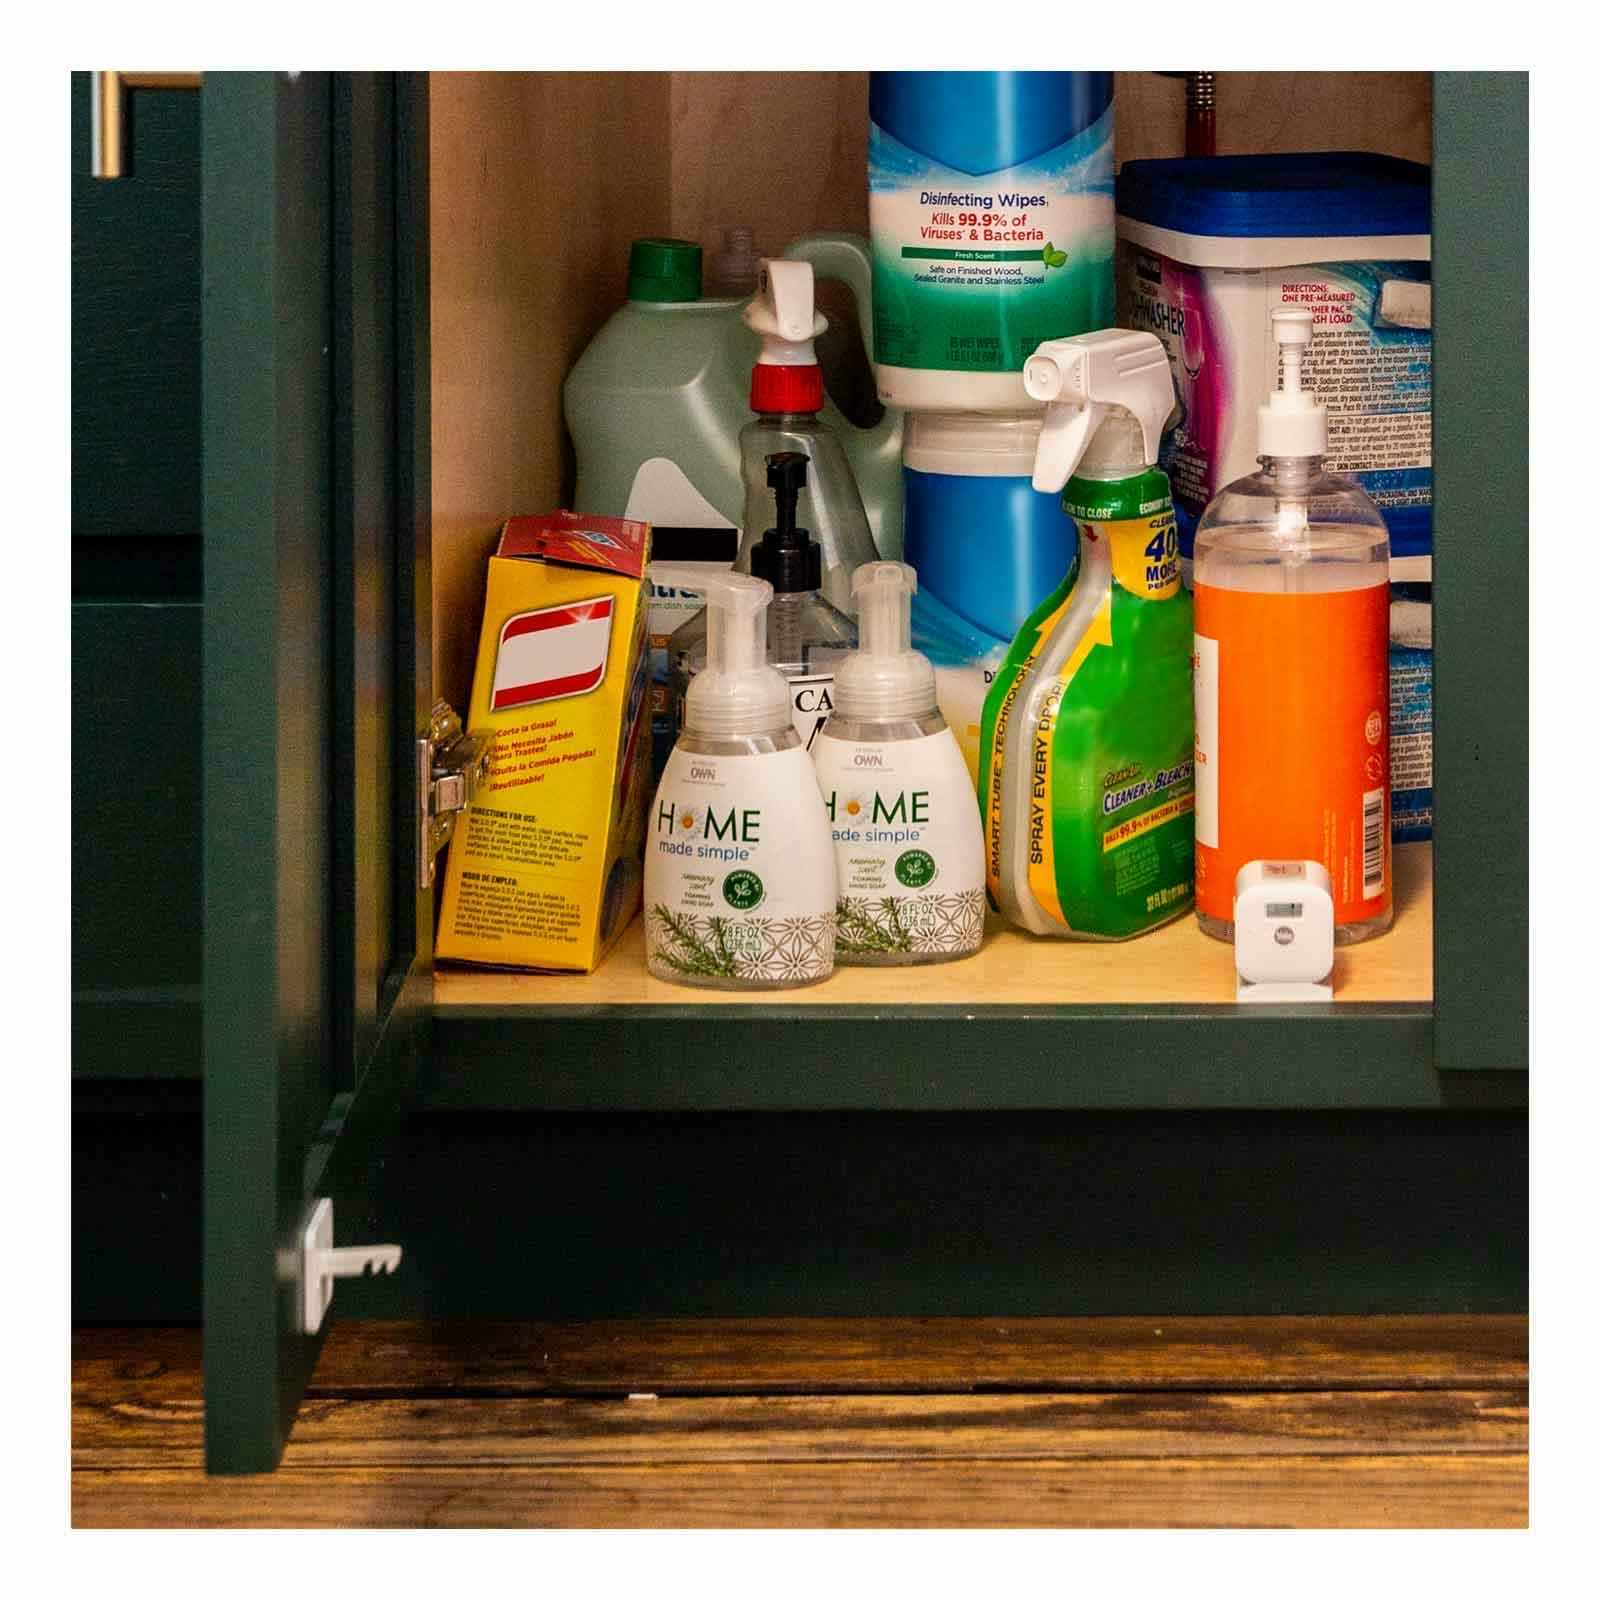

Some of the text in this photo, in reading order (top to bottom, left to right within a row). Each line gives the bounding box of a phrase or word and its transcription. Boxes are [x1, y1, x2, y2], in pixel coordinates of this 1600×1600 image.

[919, 192, 993, 209] Disinfecting
[931, 213, 1027, 227] Kills 99.9% of
[969, 229, 979, 240] &
[983, 228, 1044, 241] Bacteria
[955, 251, 995, 260] Fresh Scent
[929, 265, 945, 274] Safe
[958, 266, 992, 276] Finished
[993, 266, 1024, 277] Wood,
[914, 274, 1045, 285] Sealed Granite and Stainless Steel
[1282, 284, 1328, 293] DIRECTIONS:
[1282, 293, 1356, 302] ONE PRE-MEASURED
[1331, 305, 1344, 313] PAC
[1329, 313, 1353, 324] LOAD
[1087, 507, 1113, 520] CLOSE
[1144, 526, 1176, 563] 40
[995, 655, 1036, 755] TECHNOLOGY
[511, 736, 547, 749] Necesita
[528, 757, 561, 769] Comida
[853, 755, 883, 767] OWN
[690, 768, 716, 781] OWN
[1033, 738, 1048, 799] EVERY
[471, 806, 508, 819] DIRECTIONS
[509, 809, 522, 821] FOR
[832, 828, 920, 844] ade simple
[1030, 805, 1044, 865] SPRAY
[659, 840, 750, 862] made simple
[991, 820, 1002, 879] SMART
[462, 871, 481, 881] MODO
[481, 873, 490, 882] DE
[902, 903, 934, 914] 8 FL OZ
[727, 926, 760, 938] 8 FL OZ
